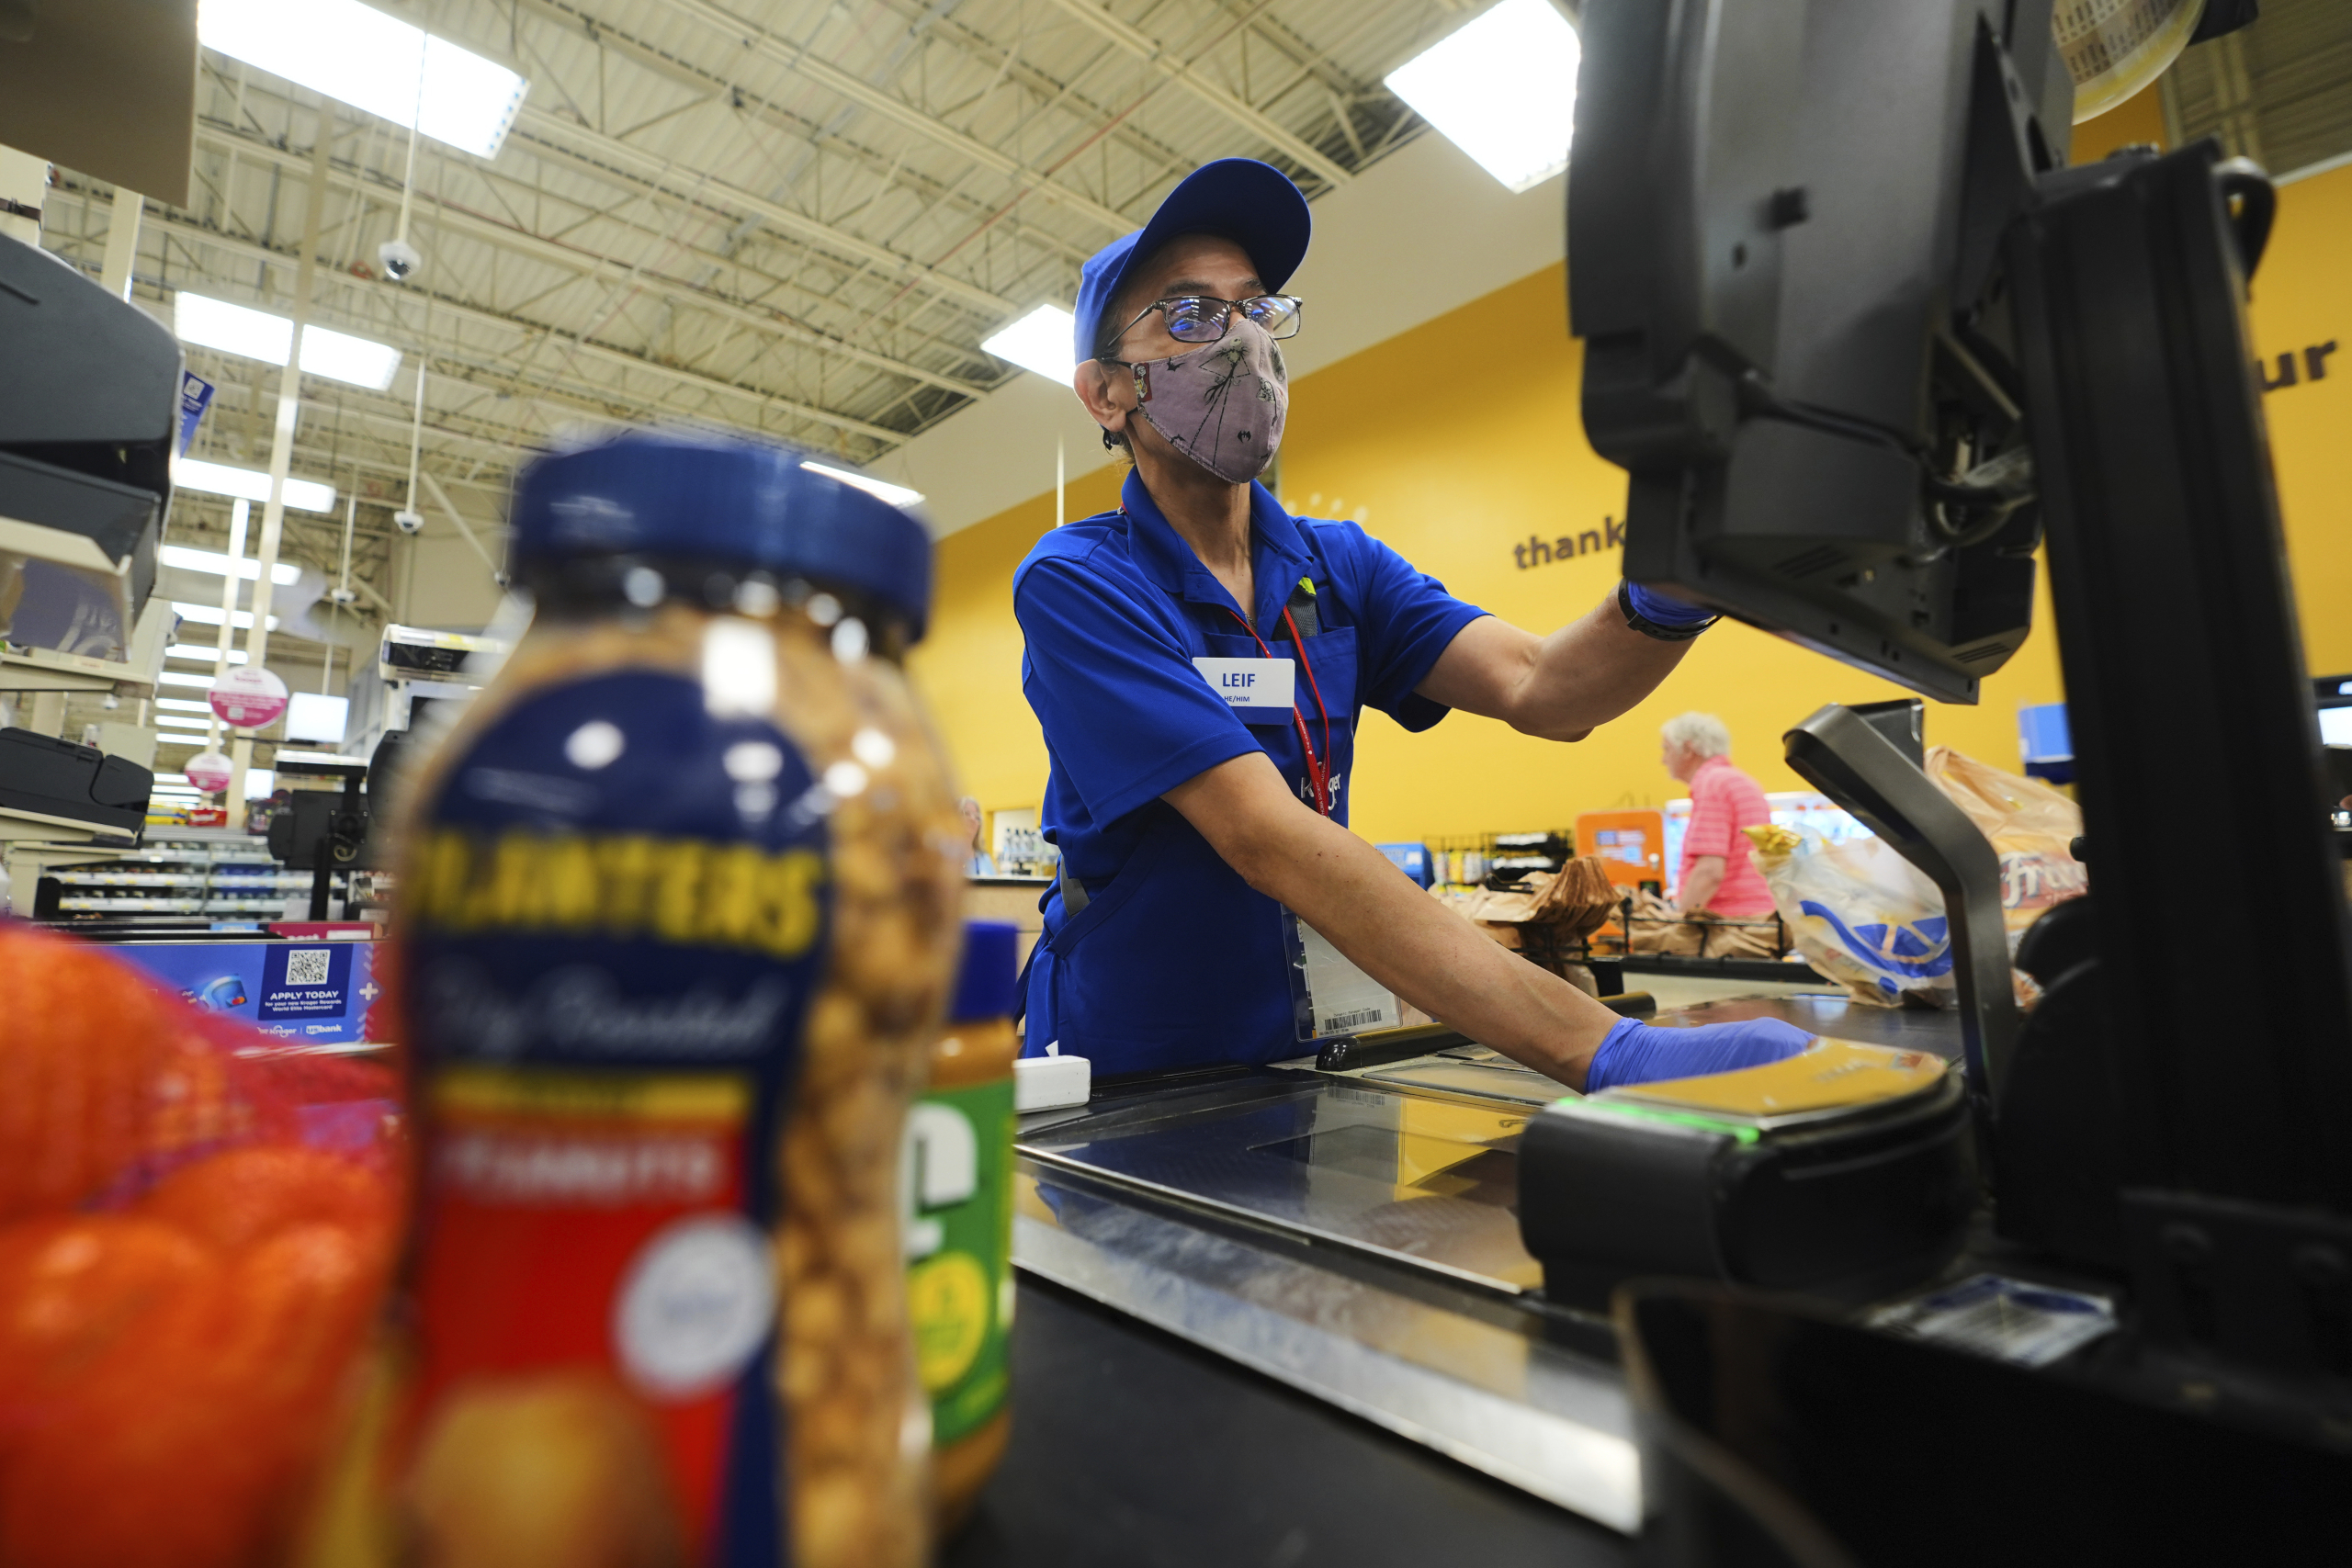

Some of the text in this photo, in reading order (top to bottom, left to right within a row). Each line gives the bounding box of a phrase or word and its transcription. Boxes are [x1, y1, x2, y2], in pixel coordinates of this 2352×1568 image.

[2257, 340, 2336, 392] ur
[1223, 673, 1255, 687] LEIF
[1301, 761, 1340, 810] Kger
[270, 990, 339, 1000] APPLY TODAY
[269, 1024, 297, 1038] Kroger
